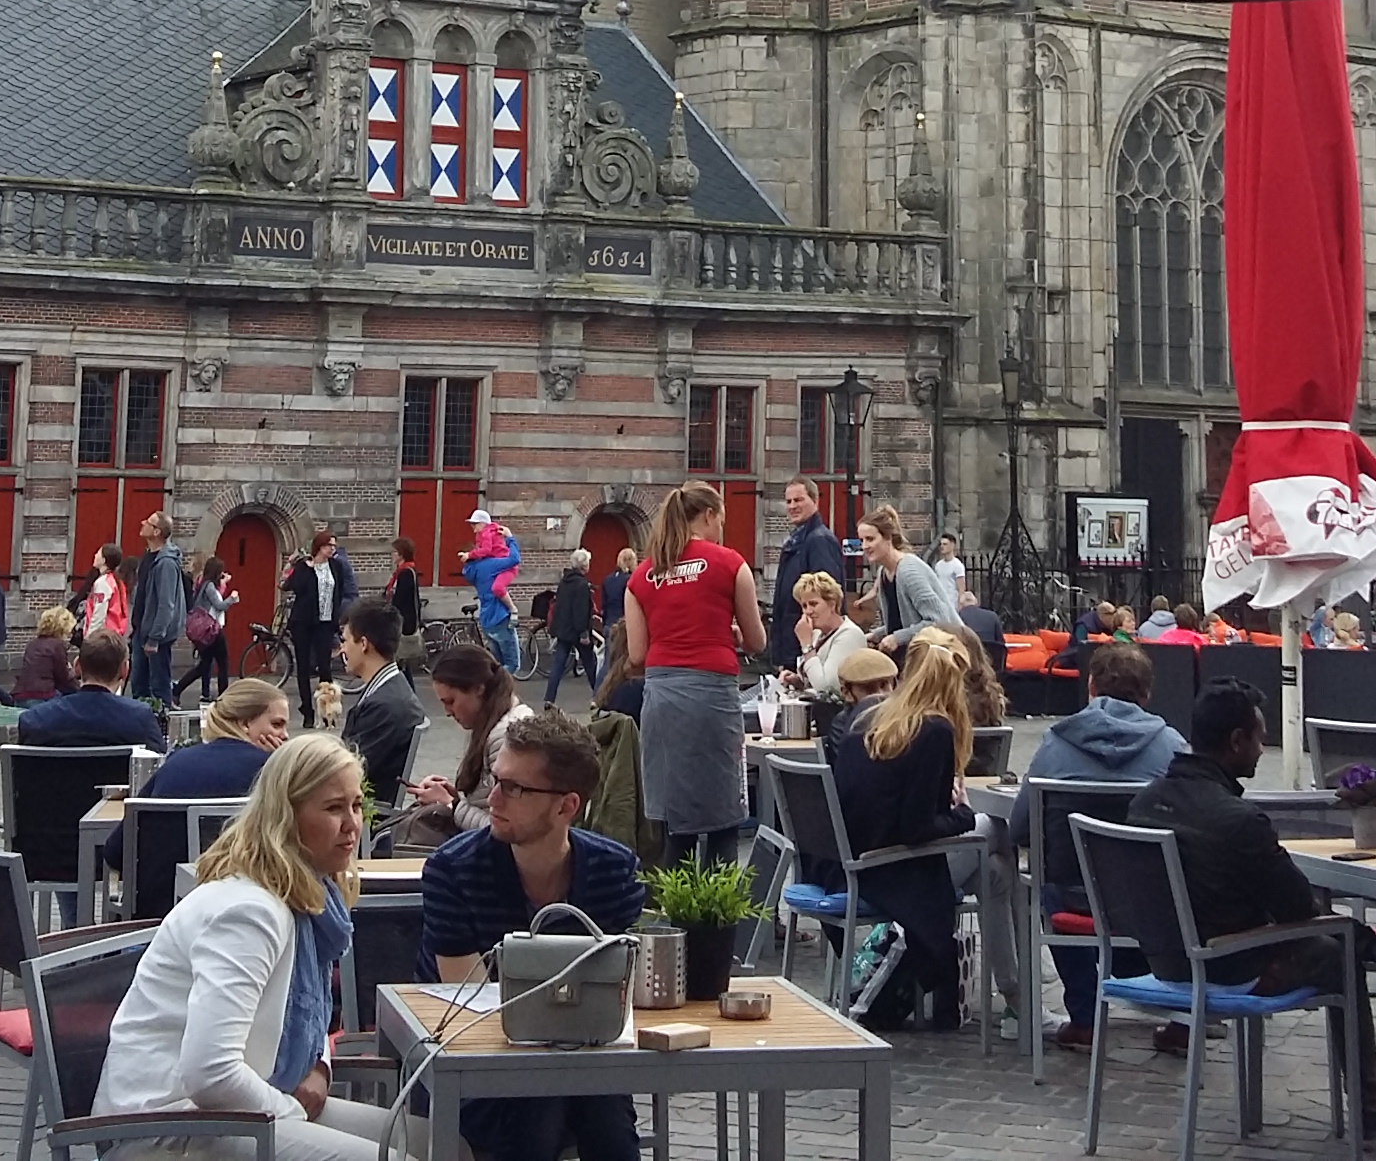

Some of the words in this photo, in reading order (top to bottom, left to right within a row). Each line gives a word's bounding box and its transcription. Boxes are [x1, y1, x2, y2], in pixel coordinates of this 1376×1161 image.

[239, 225, 305, 251] ANNO
[367, 234, 443, 257] VIGILATE
[445, 241, 467, 258] ET
[470, 239, 529, 261] ORATE
